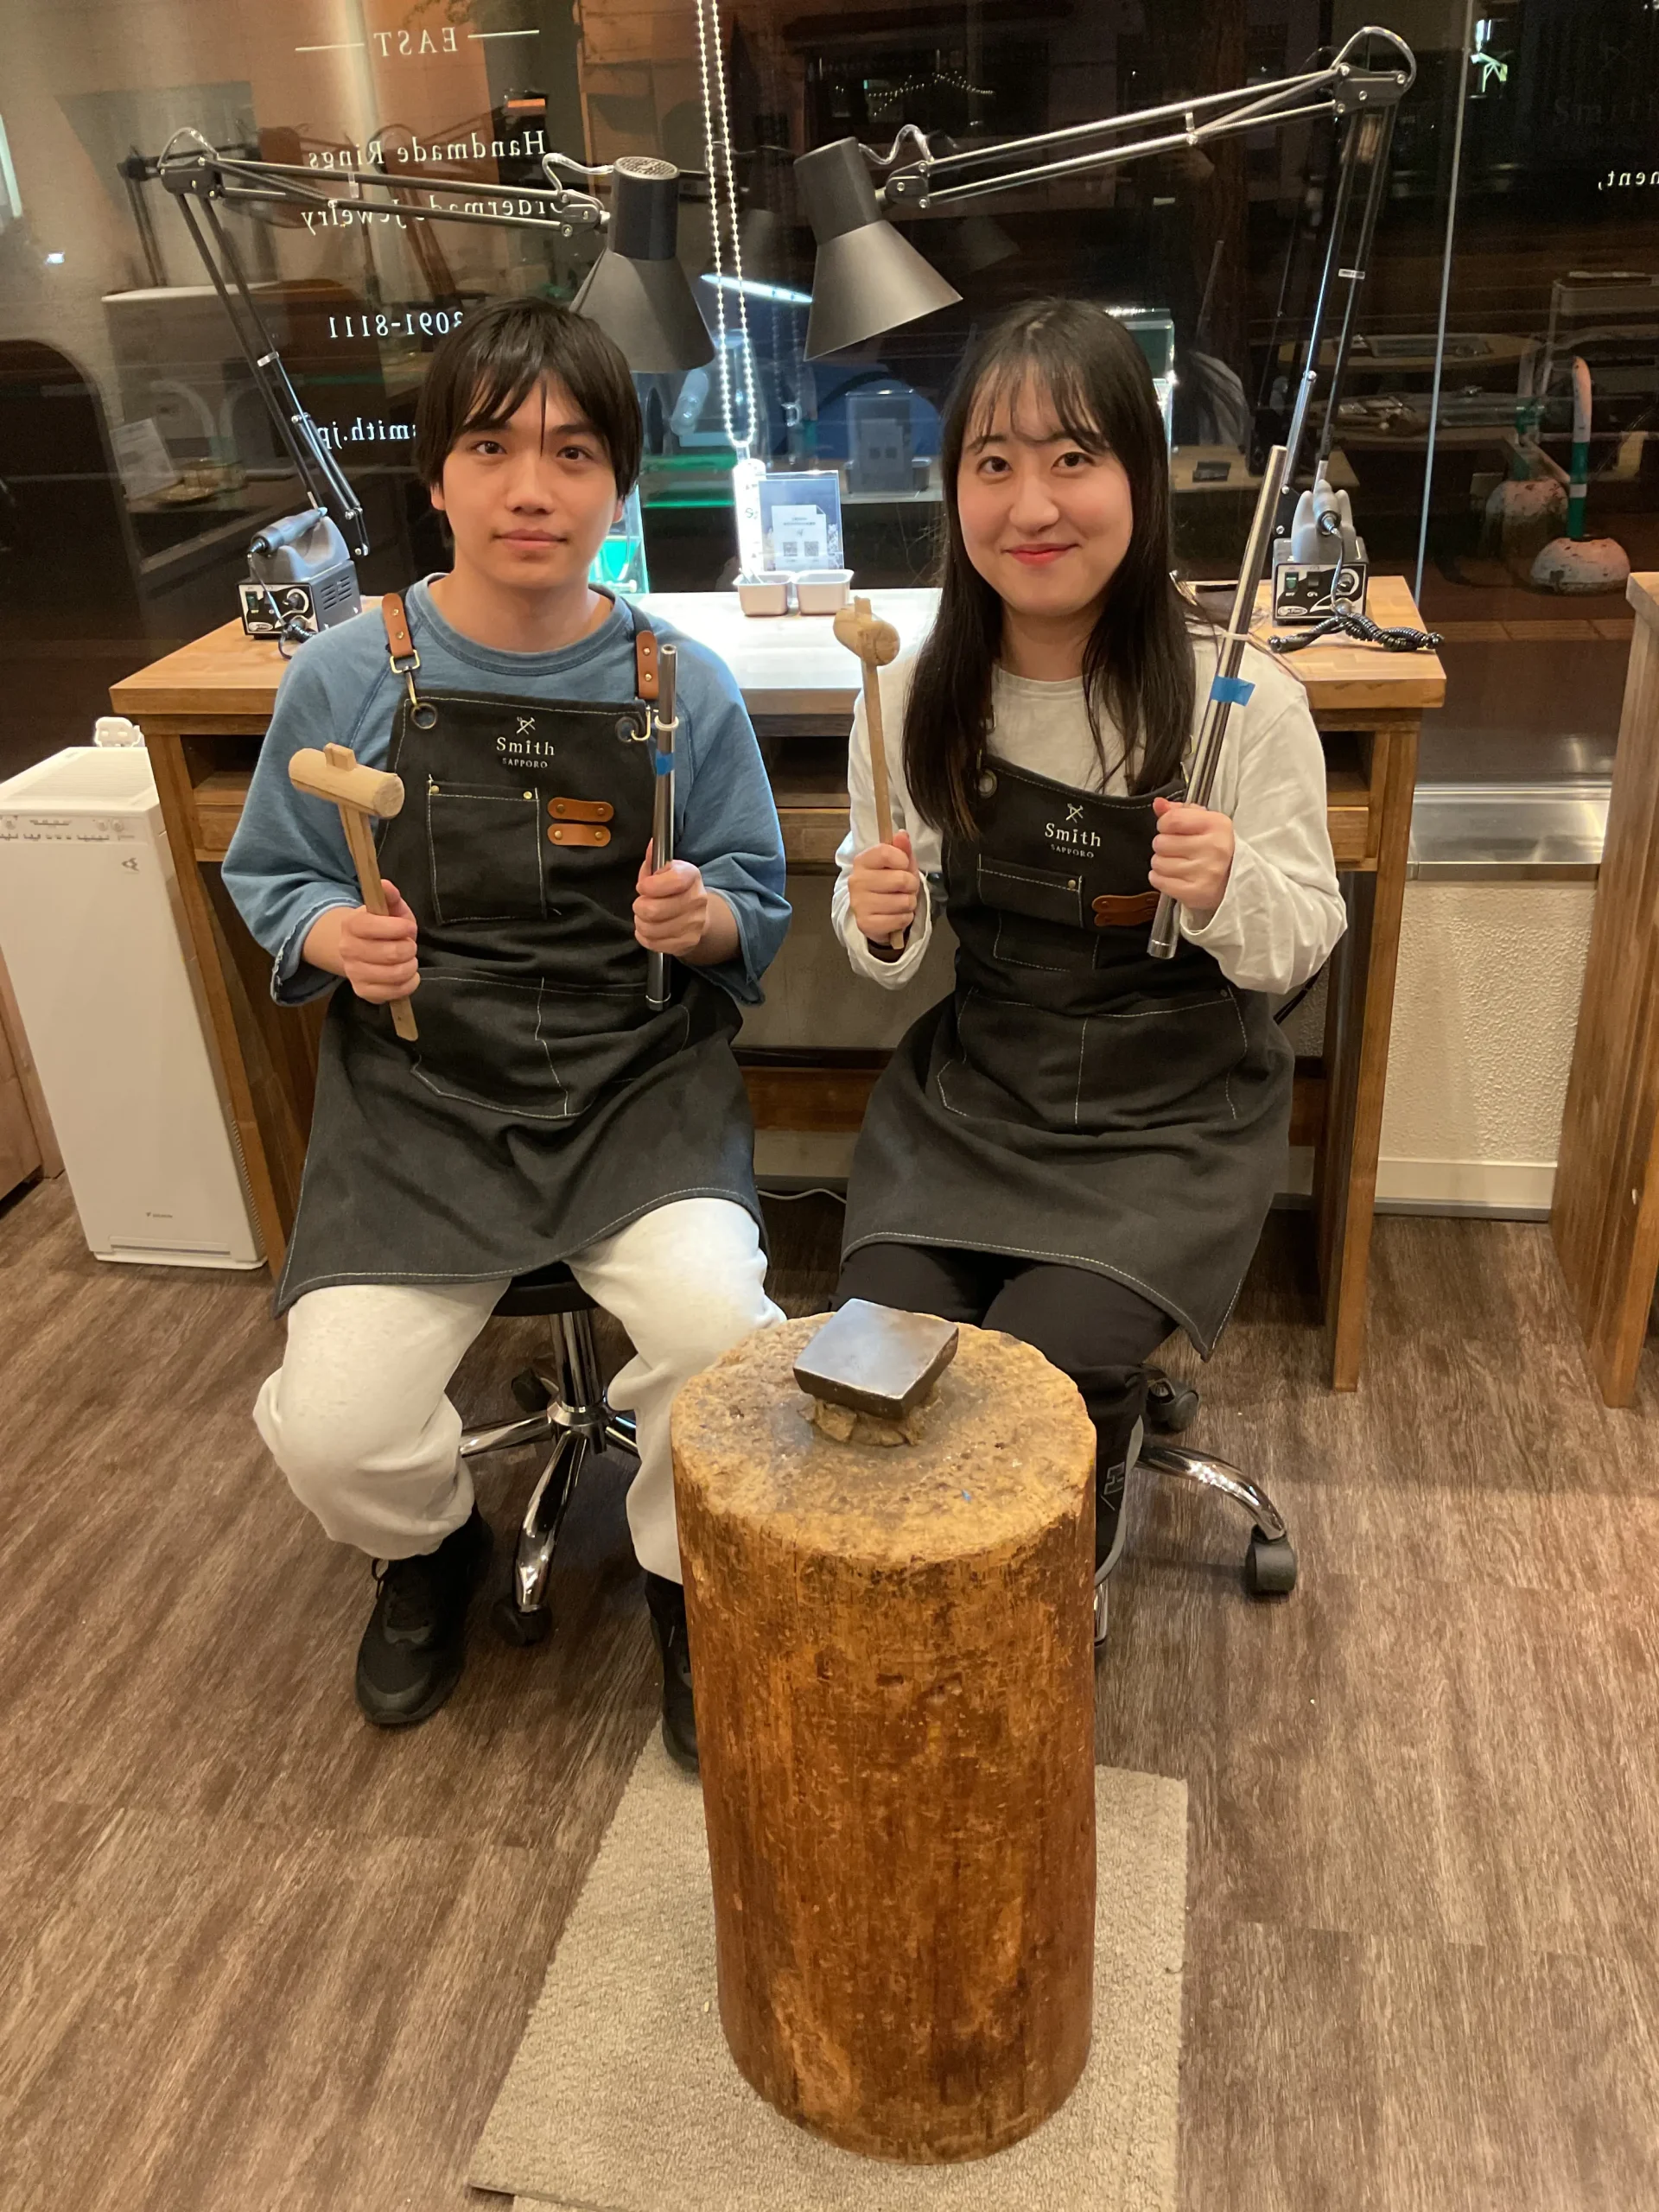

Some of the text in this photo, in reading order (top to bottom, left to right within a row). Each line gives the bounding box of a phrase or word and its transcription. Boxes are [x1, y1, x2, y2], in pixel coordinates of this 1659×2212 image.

[496, 736, 555, 756] Smith
[502, 757, 548, 768] SAPPORO
[1045, 823, 1101, 847] Smith
[1051, 843, 1094, 858] SAPPORO
